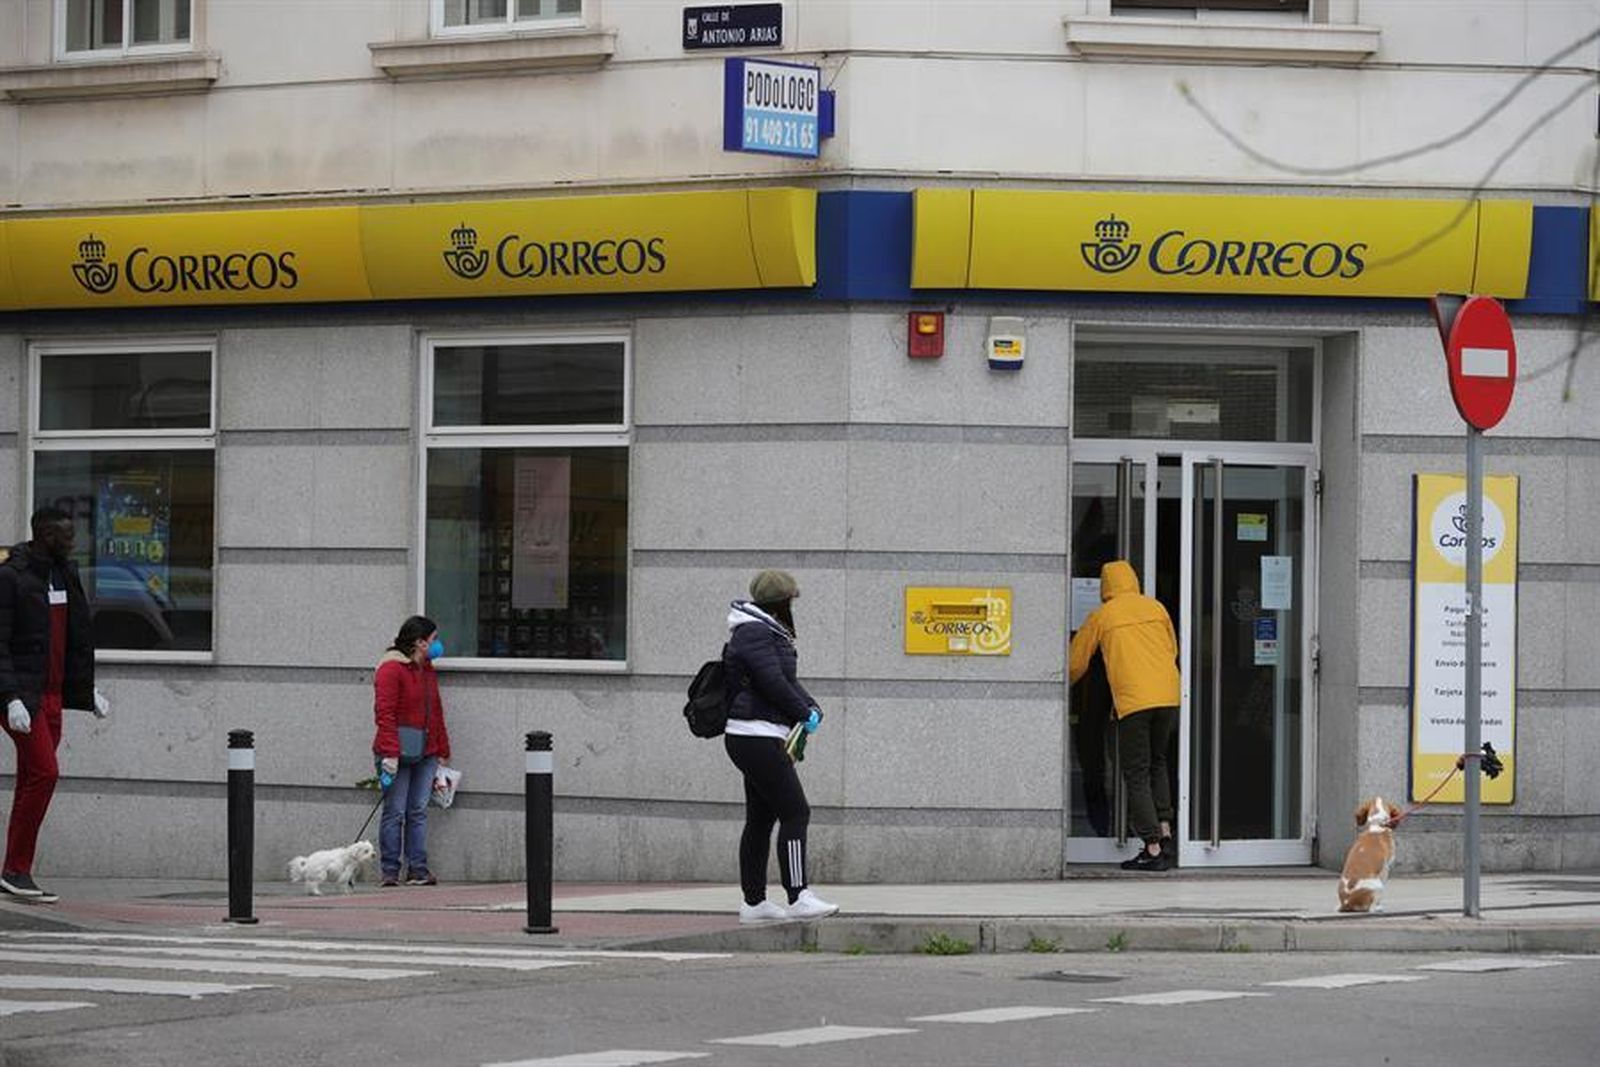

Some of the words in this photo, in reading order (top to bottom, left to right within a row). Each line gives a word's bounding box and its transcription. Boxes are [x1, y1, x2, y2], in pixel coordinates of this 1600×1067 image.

[702, 12, 719, 22] CALLE
[721, 12, 729, 21] DE
[702, 28, 745, 43] ANTONIO
[750, 26, 778, 42] ARIAS
[746, 117, 758, 143] 91
[762, 118, 783, 146] 409
[785, 121, 798, 148] 21
[800, 123, 814, 149] 65
[1439, 534, 1496, 549] Coros
